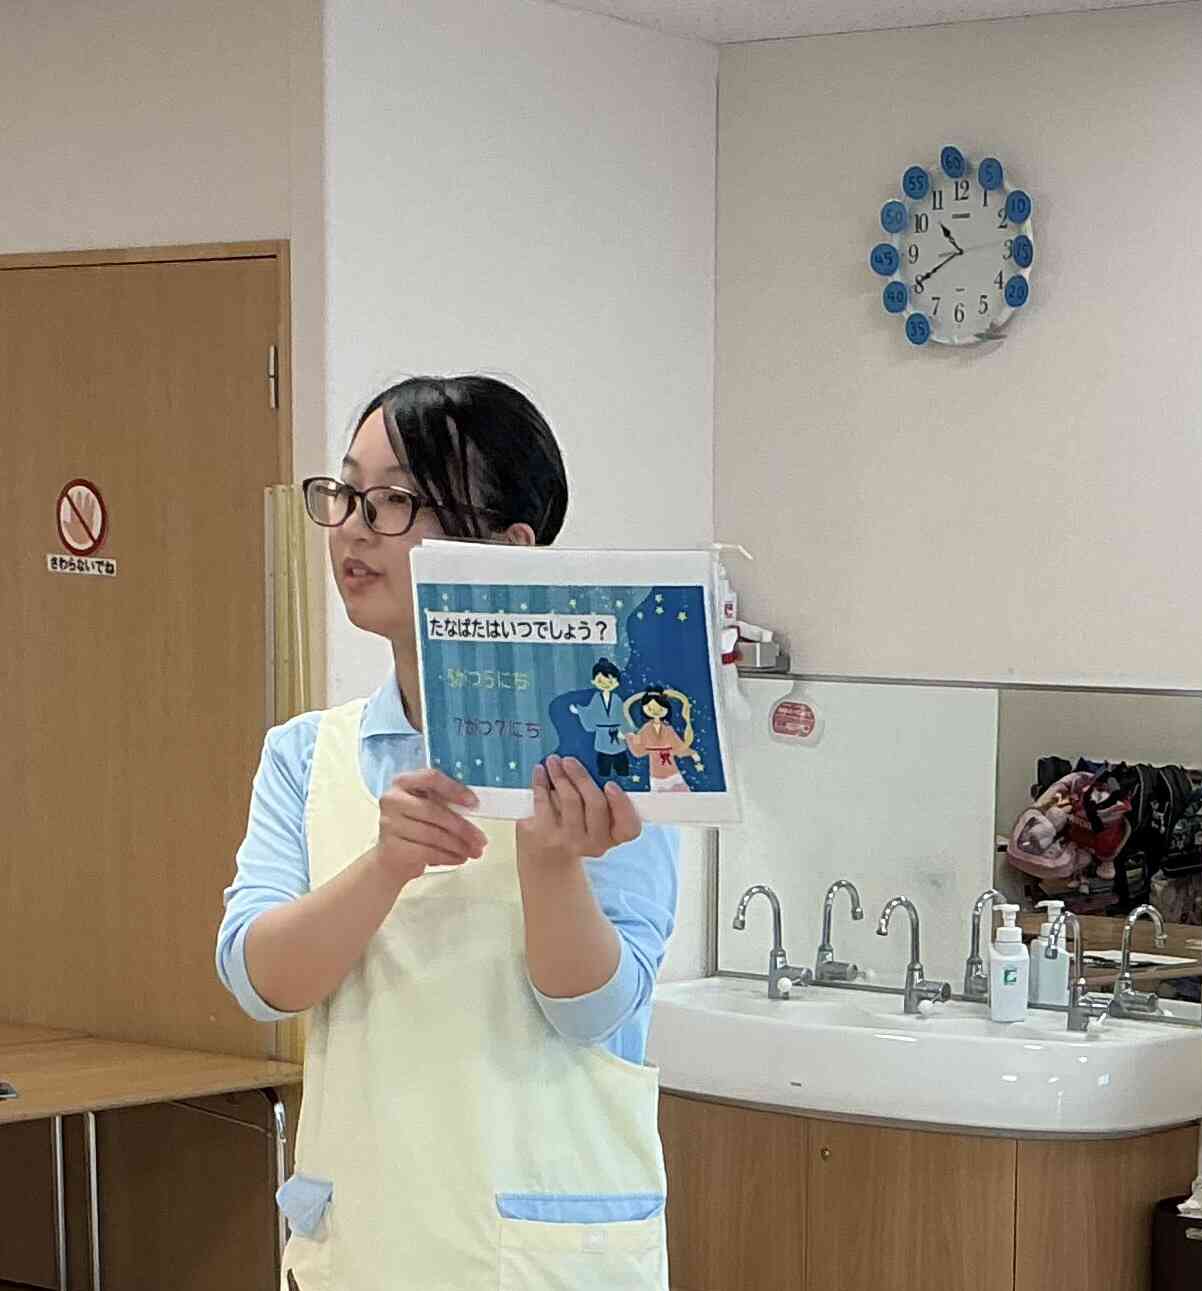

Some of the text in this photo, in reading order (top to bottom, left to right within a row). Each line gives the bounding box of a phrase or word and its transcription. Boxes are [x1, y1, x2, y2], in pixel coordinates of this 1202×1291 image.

[908, 175, 925, 192] 55
[985, 165, 995, 183] 5
[931, 190, 944, 211] 11
[953, 180, 970, 201] 12
[1011, 199, 1026, 215] 10
[913, 213, 929, 234] 10
[997, 208, 1008, 229] 2
[875, 251, 894, 267] 45
[908, 244, 919, 265] 9
[1002, 239, 1014, 261] 3
[911, 274, 926, 294] 8
[993, 271, 1005, 290] 4
[1008, 285, 1025, 301] 20
[931, 296, 941, 316] 7
[954, 303, 965, 323] 6
[978, 295, 989, 314] 5
[910, 320, 926, 336] 35
